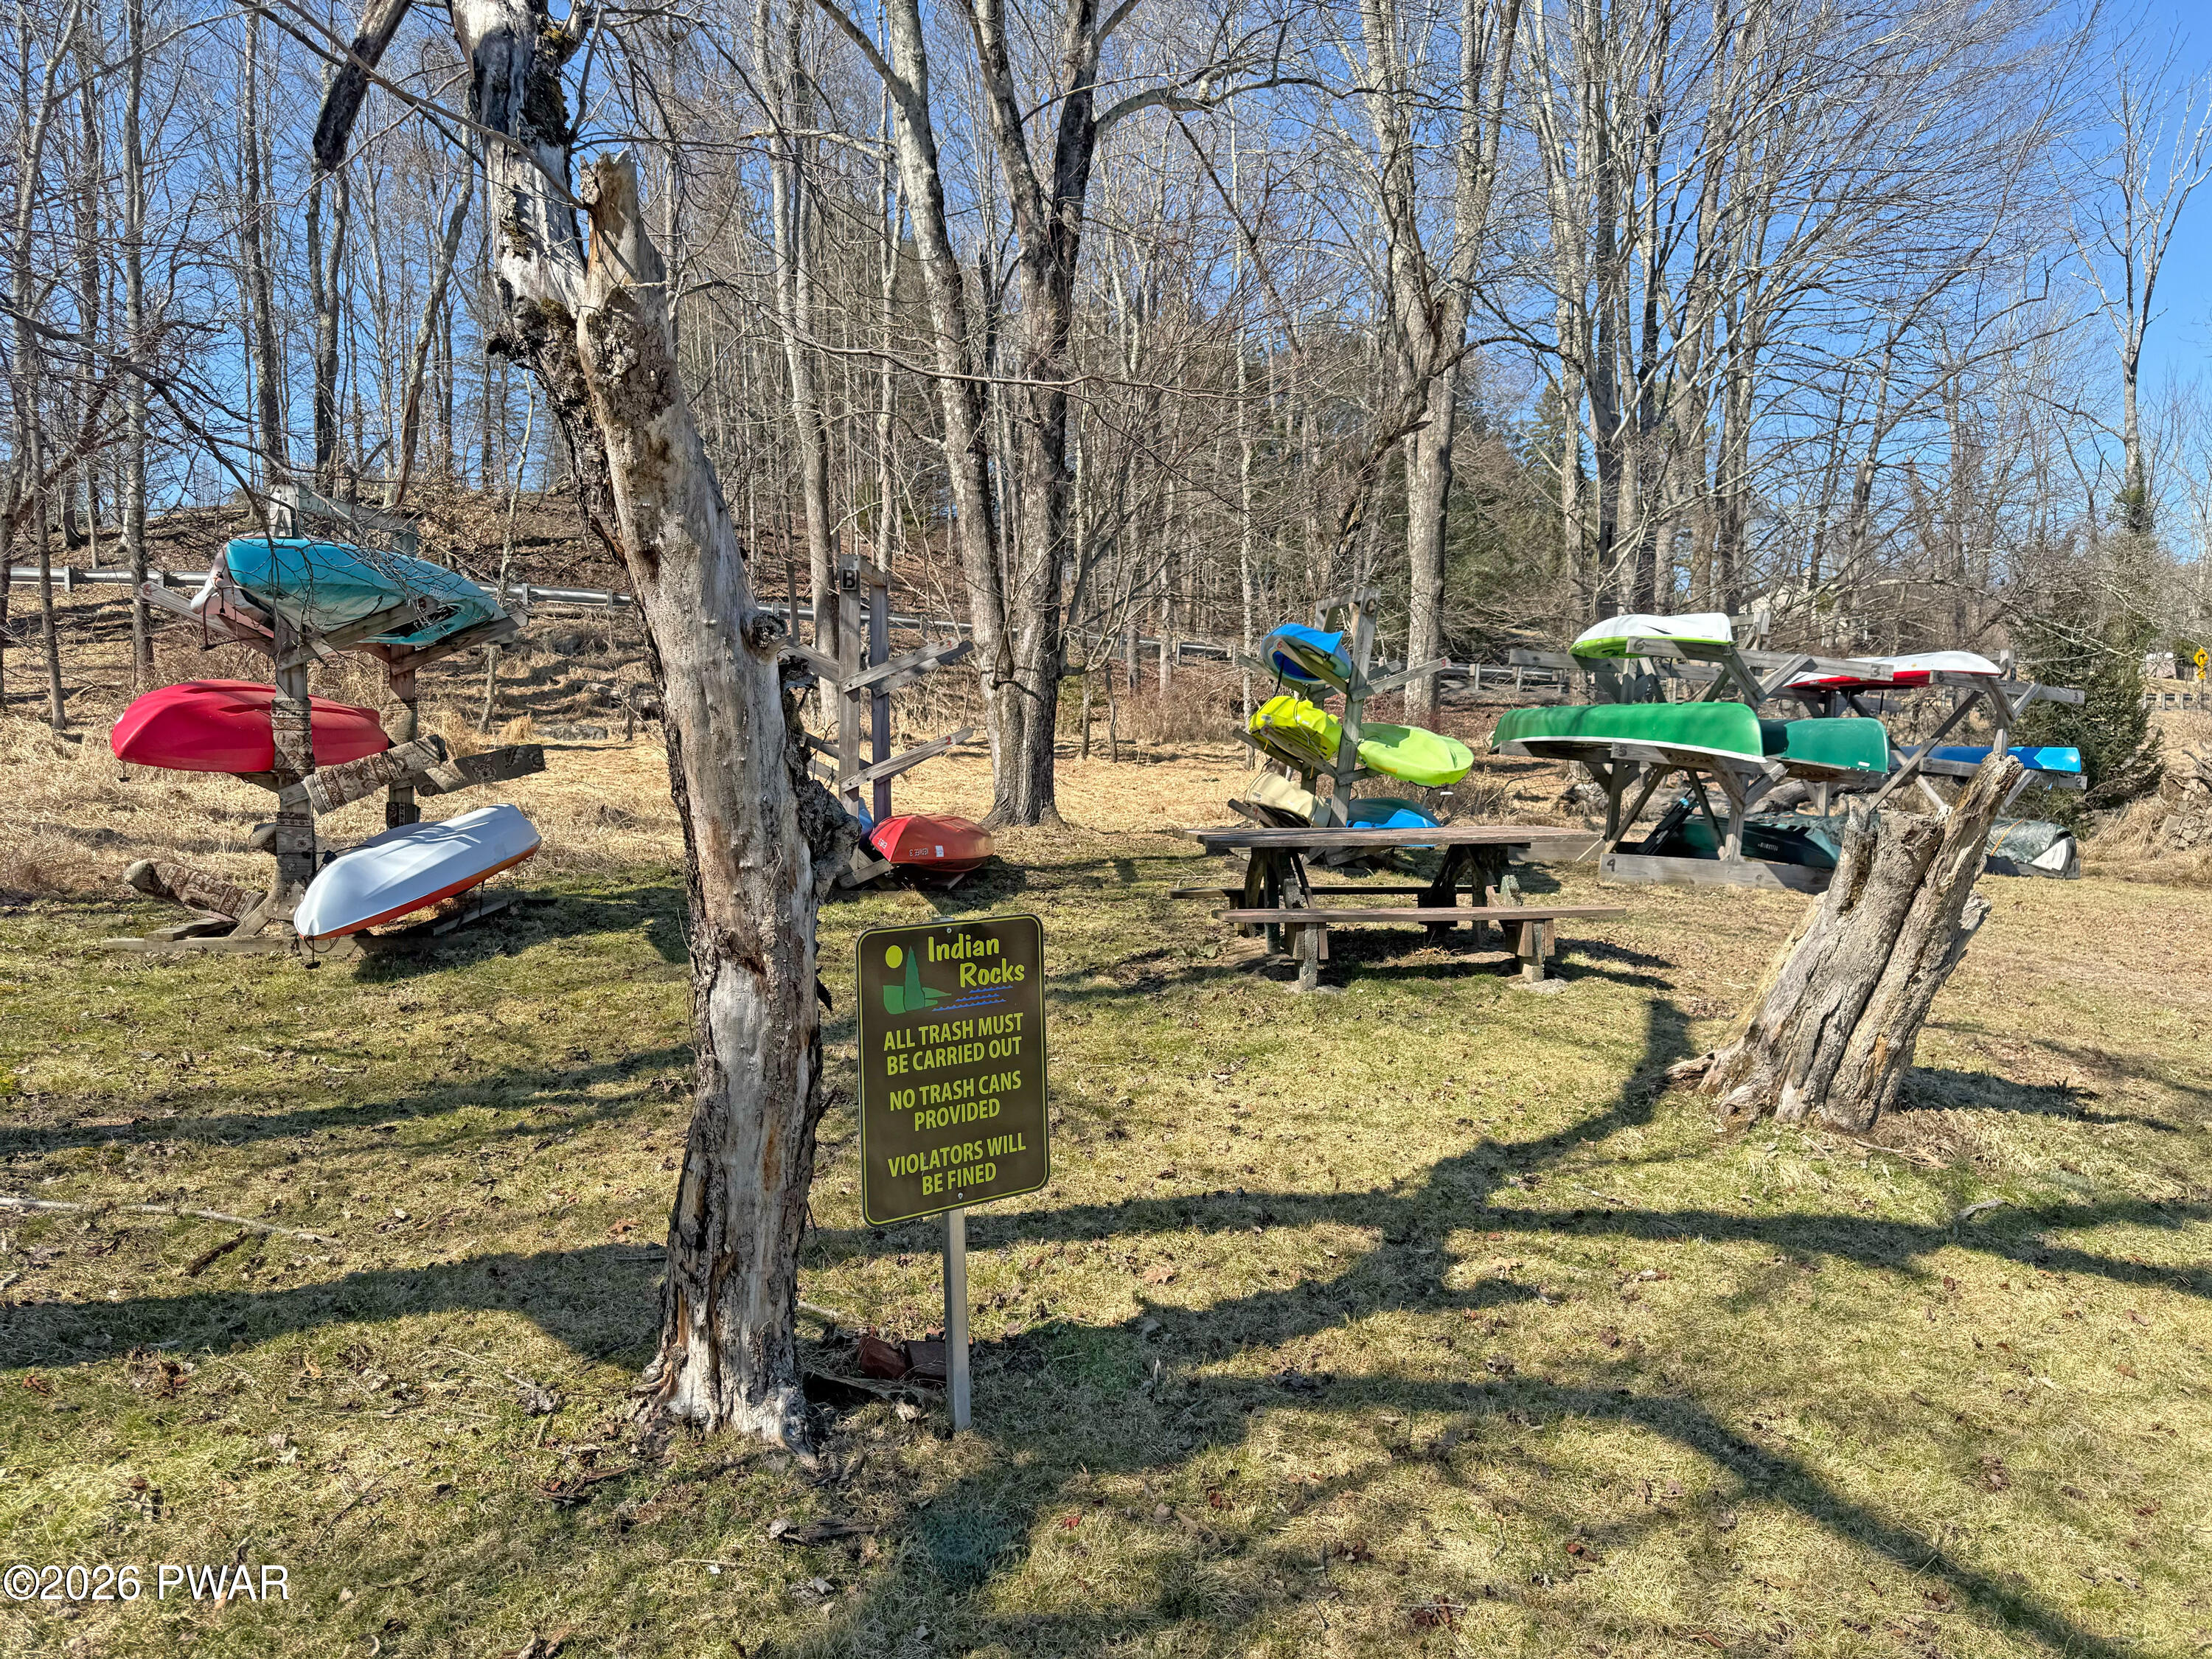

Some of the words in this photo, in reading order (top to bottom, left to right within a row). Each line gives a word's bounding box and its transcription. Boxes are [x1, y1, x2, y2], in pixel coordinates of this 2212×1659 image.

[274, 509, 291, 536] A
[842, 569, 856, 588] B
[1365, 598, 1377, 613] C
[946, 640, 953, 649] 3
[1276, 640, 1283, 649] 6
[1633, 639, 1646, 651] 6
[1871, 664, 1881, 678] 3
[945, 736, 953, 745] 2
[1619, 744, 1628, 757] 5
[928, 933, 1000, 963] Indian
[959, 958, 1025, 988] Rocks
[883, 1028, 916, 1051] ALL
[919, 1019, 976, 1046] TRASH
[978, 1012, 1024, 1034] MUST
[887, 1054, 909, 1076] BE
[912, 1043, 985, 1071] CARRIED
[989, 1036, 1022, 1059] OUT
[890, 1088, 916, 1111] NO
[919, 1079, 975, 1106] TRASH
[979, 1070, 1022, 1094] CANS
[914, 1098, 1001, 1132] PROVIDED
[888, 1140, 984, 1178] VIOLATORS
[987, 1133, 1026, 1155] WILL
[922, 1174, 944, 1196] BE
[947, 1161, 997, 1191] FINED
